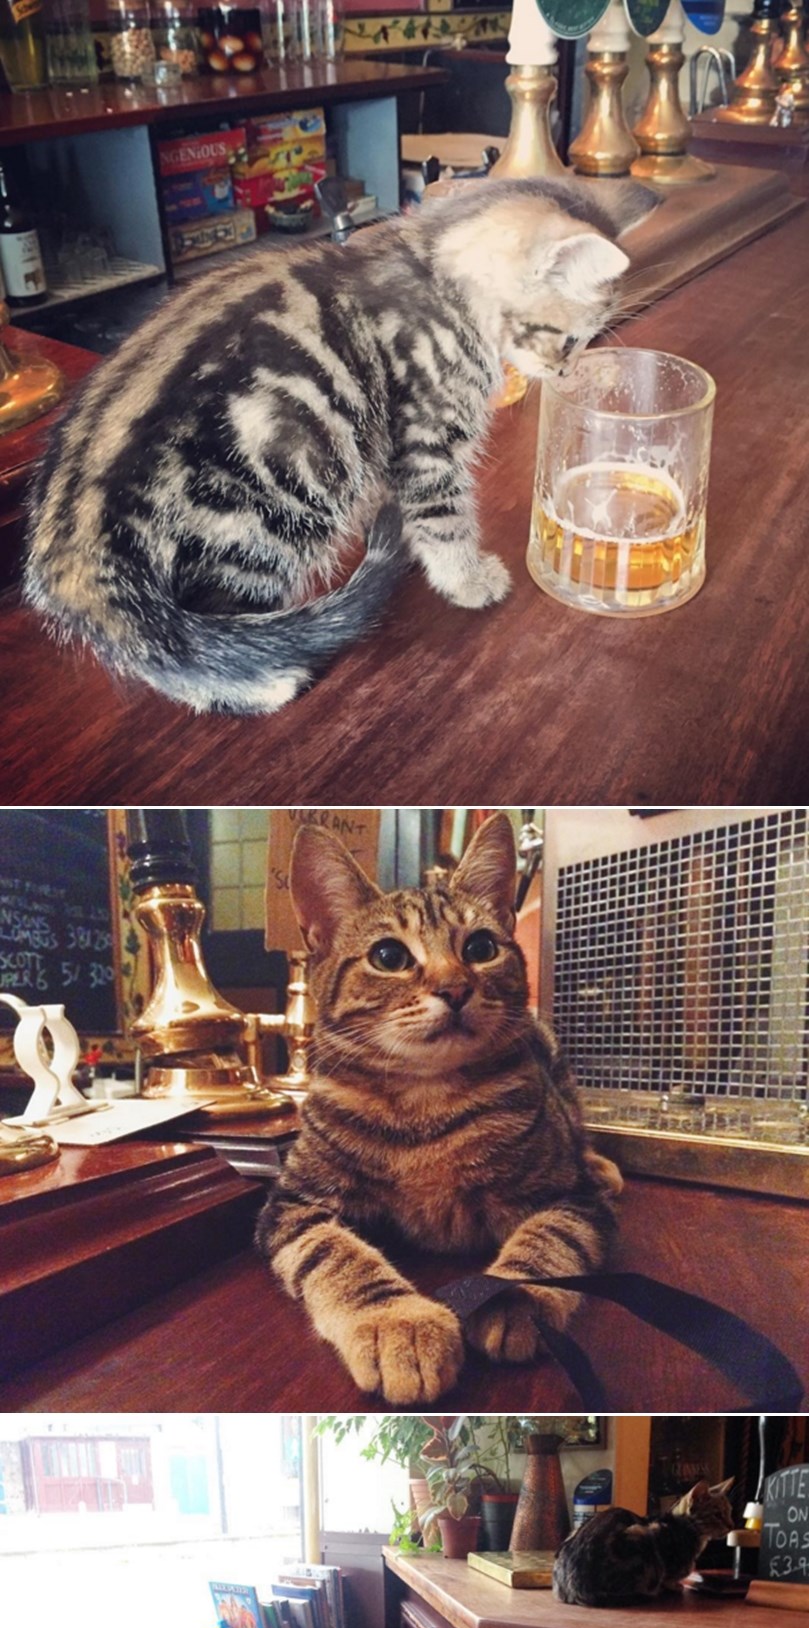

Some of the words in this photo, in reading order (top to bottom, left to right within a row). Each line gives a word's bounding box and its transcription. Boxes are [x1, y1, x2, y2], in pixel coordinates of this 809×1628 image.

[766, 1468, 809, 1501] KITTE
[764, 1522, 809, 1549] TOAS
[769, 1555, 809, 1578] £3.9
